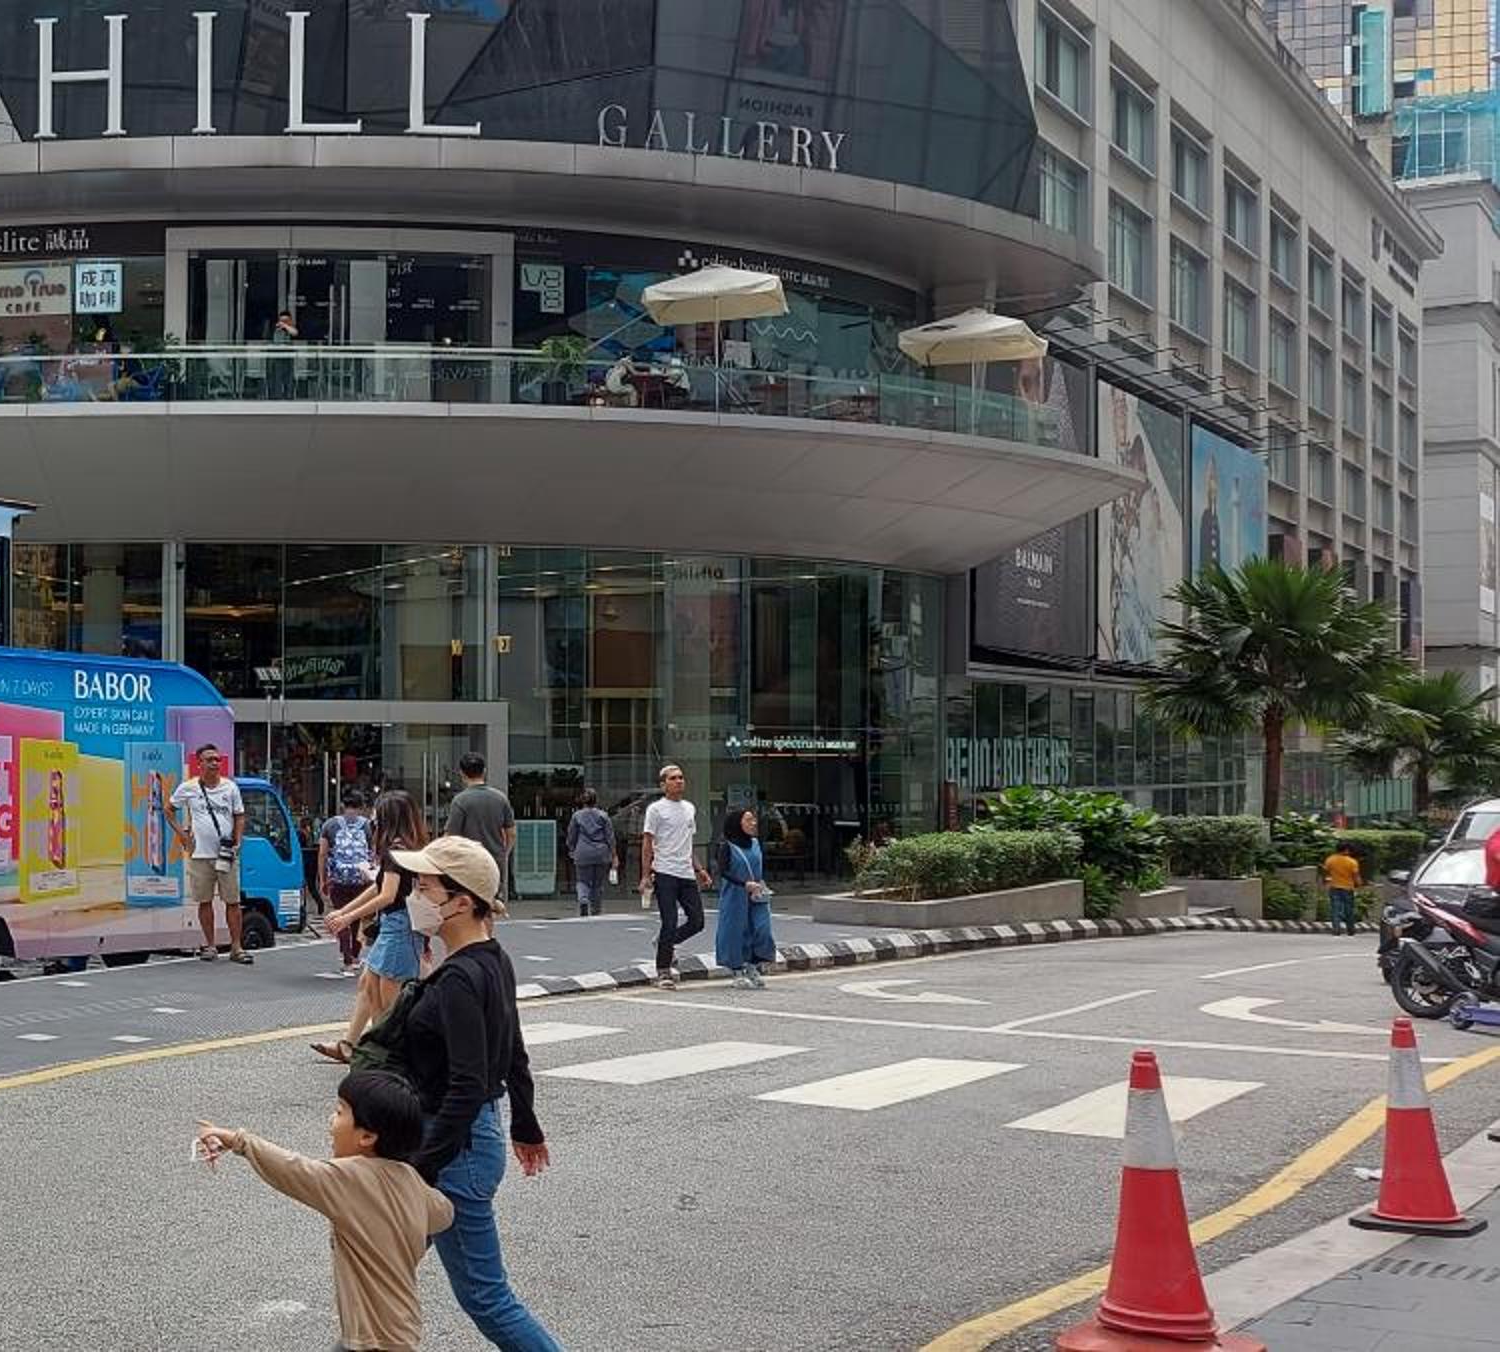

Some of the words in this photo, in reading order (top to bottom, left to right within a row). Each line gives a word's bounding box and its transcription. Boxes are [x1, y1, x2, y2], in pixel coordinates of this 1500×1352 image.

[598, 103, 847, 172] GALLERY
[5, 302, 41, 314] CAFE
[1015, 547, 1054, 576] BALMAIN
[73, 669, 154, 703] BABOR
[73, 705, 108, 719] EXPERT
[110, 708, 131, 720] SKIN
[73, 721, 100, 735] MADE
[101, 723, 111, 735] IN
[112, 723, 155, 737] GERMANY
